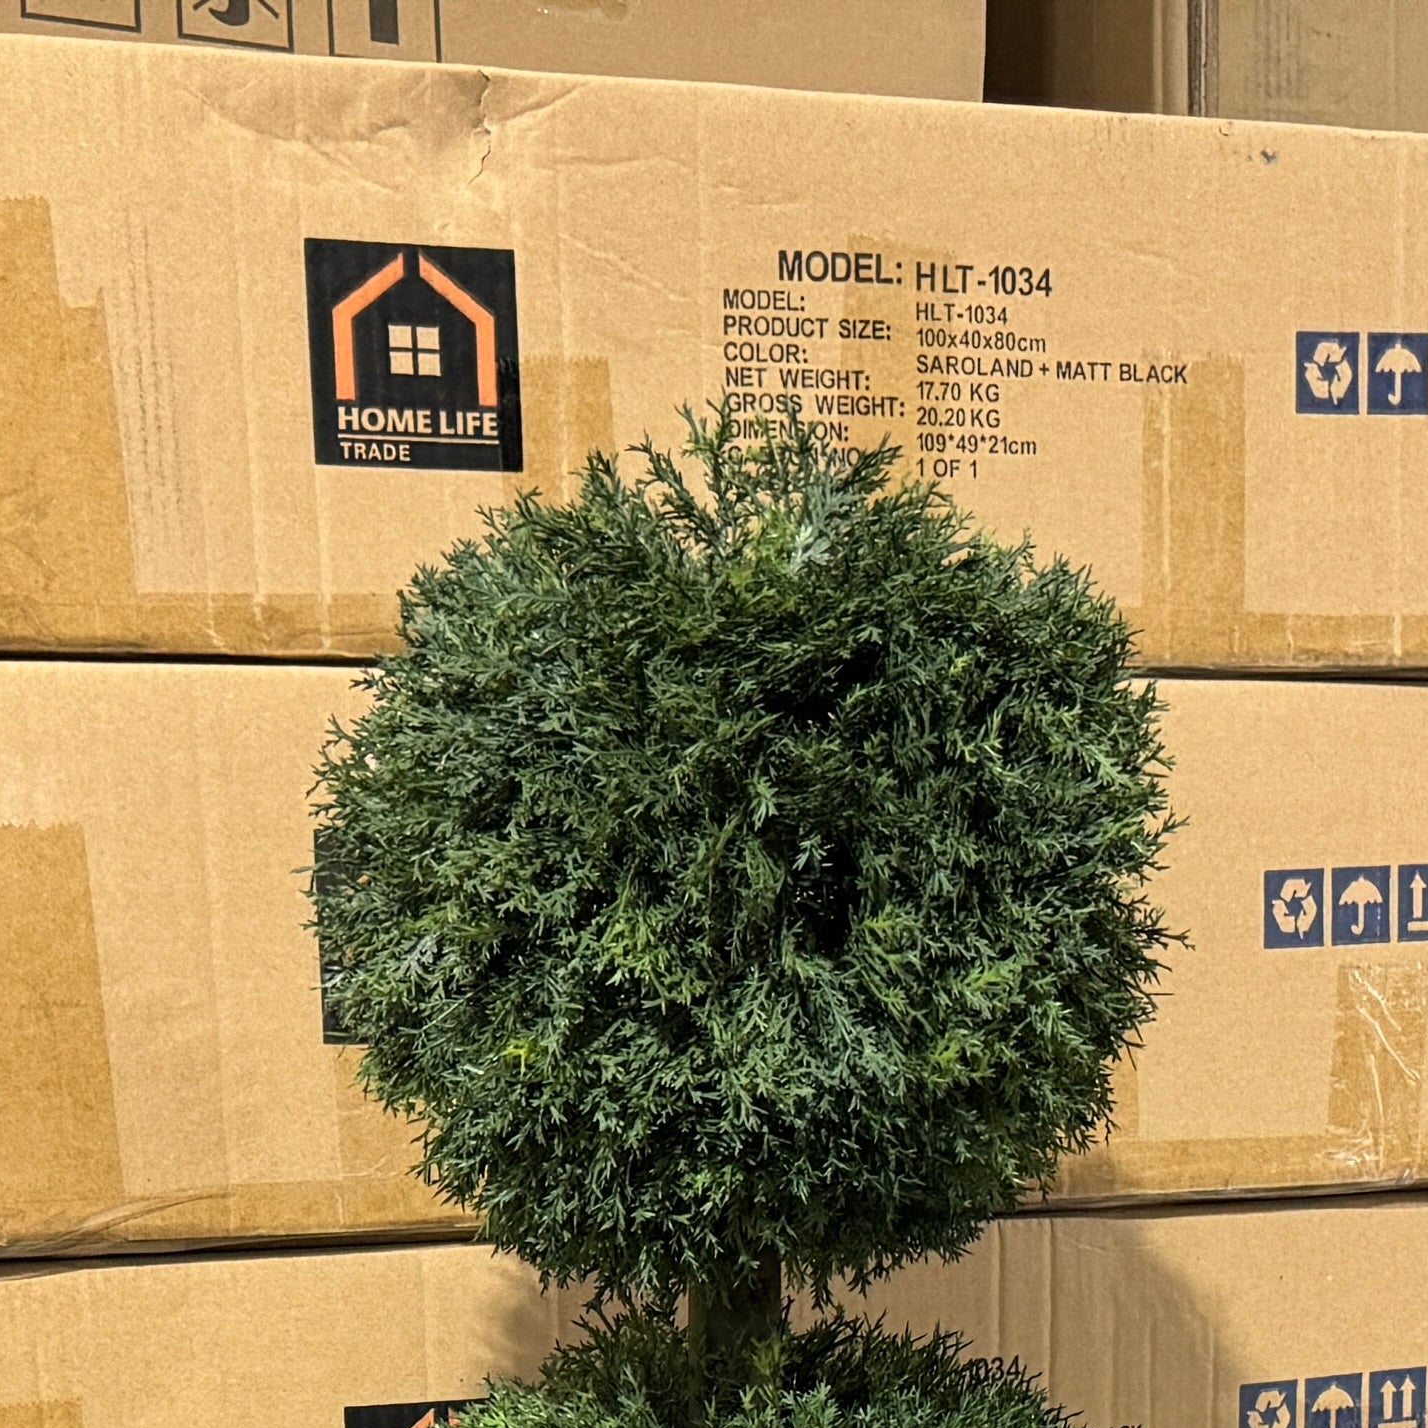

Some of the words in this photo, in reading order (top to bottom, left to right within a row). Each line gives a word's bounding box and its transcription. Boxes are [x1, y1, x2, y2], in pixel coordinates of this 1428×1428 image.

[778, 250, 903, 286] MODEL:
[915, 262, 1053, 297] HLT-1034
[723, 289, 805, 312] MODEL:
[916, 302, 1008, 325] HLT-1034
[723, 315, 829, 340] PRODUCT
[839, 318, 892, 342] SIZE:
[916, 329, 1047, 353] 100x40x80cm
[724, 341, 808, 365] COLOR:
[916, 354, 1033, 379] SAROLAND
[1056, 360, 1111, 382] MATT
[1118, 362, 1187, 385] BLACK
[725, 367, 767, 388] NET
[779, 368, 870, 392] WEIGHT:
[916, 382, 963, 402] 17.70
[970, 383, 1000, 403] KG
[338, 406, 432, 434] HOME
[439, 411, 499, 436] LIFE
[725, 392, 803, 414] GROSS
[815, 394, 905, 417] WEIGHT:
[917, 408, 965, 428] 20.20
[971, 409, 1001, 429] KG
[340, 442, 411, 462] TRADE
[917, 459, 925, 477] 1
[934, 458, 961, 477] OF
[970, 460, 978, 479] 1
